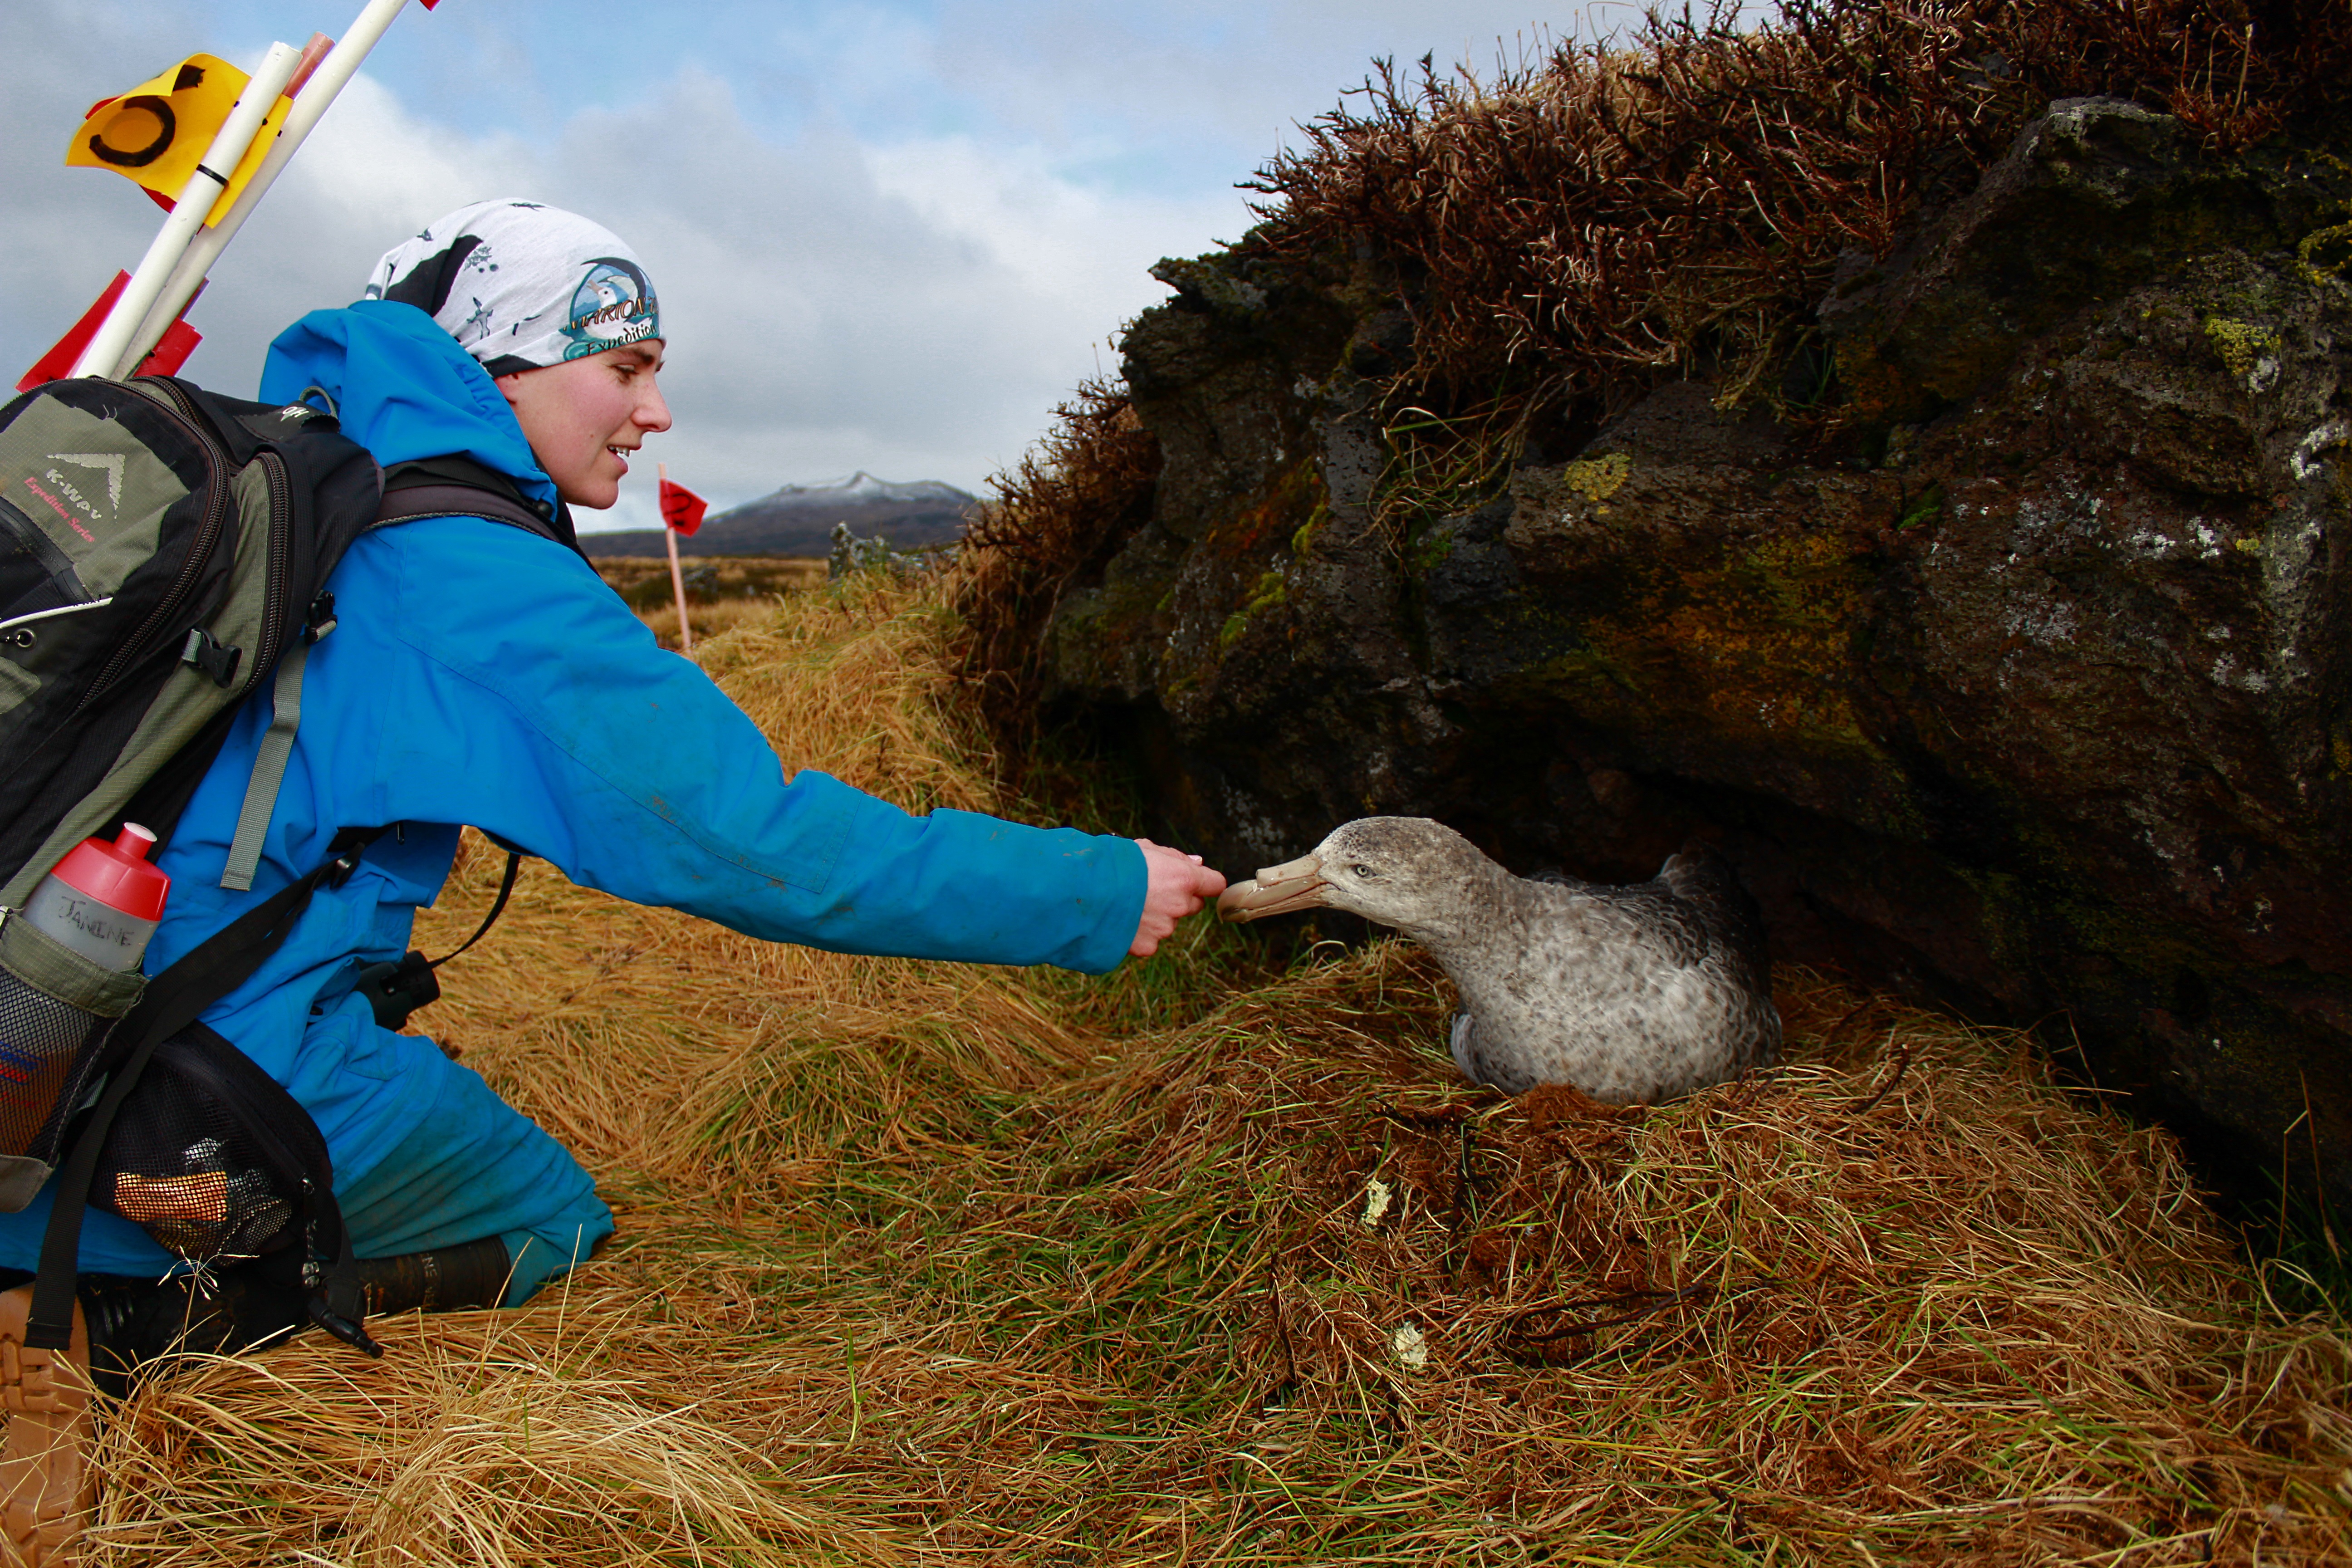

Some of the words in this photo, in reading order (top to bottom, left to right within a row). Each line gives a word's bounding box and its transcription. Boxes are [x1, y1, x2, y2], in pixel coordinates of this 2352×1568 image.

[586, 323, 657, 355] Expedition
[24, 476, 70, 519] Expedition
[68, 517, 95, 543] Series
[59, 896, 135, 946] JANINE
